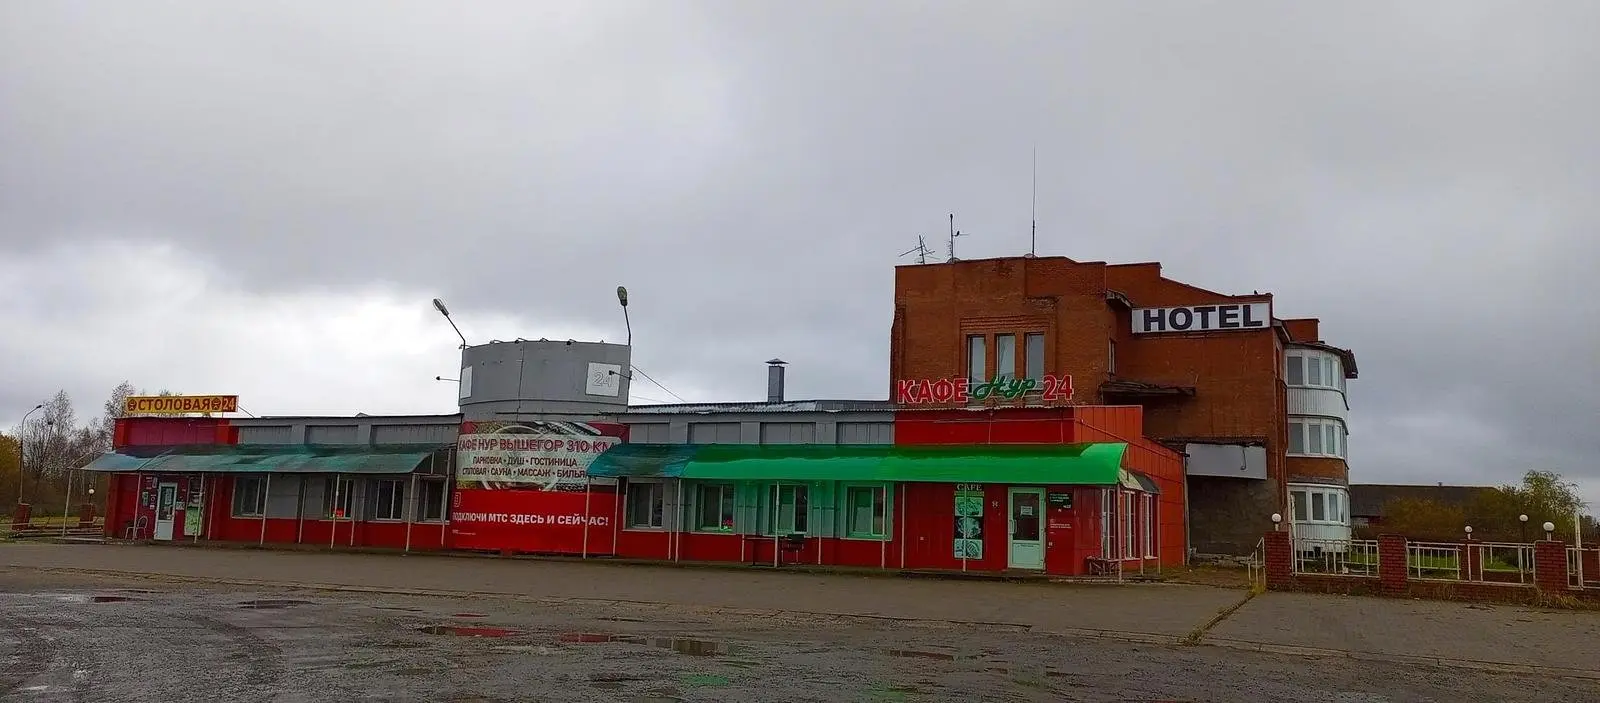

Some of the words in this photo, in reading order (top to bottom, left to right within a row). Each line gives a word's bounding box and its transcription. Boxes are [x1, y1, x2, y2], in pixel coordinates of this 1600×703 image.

[1143, 305, 1263, 331] HOTEL
[592, 371, 613, 388] 24
[897, 378, 968, 404] КАФЕ
[972, 375, 1037, 399] Нур
[1042, 374, 1075, 401] 24
[138, 398, 210, 411] СТОЛОВАЯ
[223, 398, 235, 410] 24
[478, 439, 498, 451] НУР
[499, 439, 564, 452] ВЫШЕГОР
[566, 440, 590, 452] 310
[507, 457, 525, 466] ДУШ
[530, 457, 578, 467] ГОСТИНИЦА
[490, 468, 512, 476] САУНА
[517, 468, 551, 477] МАССАЖ
[452, 512, 487, 523] ПОДКЛЮЧИ
[488, 513, 508, 523] МТС
[510, 514, 545, 525] ЗДЕСЬ
[546, 515, 555, 524] И
[557, 513, 609, 526] СЕЙЧАС!
